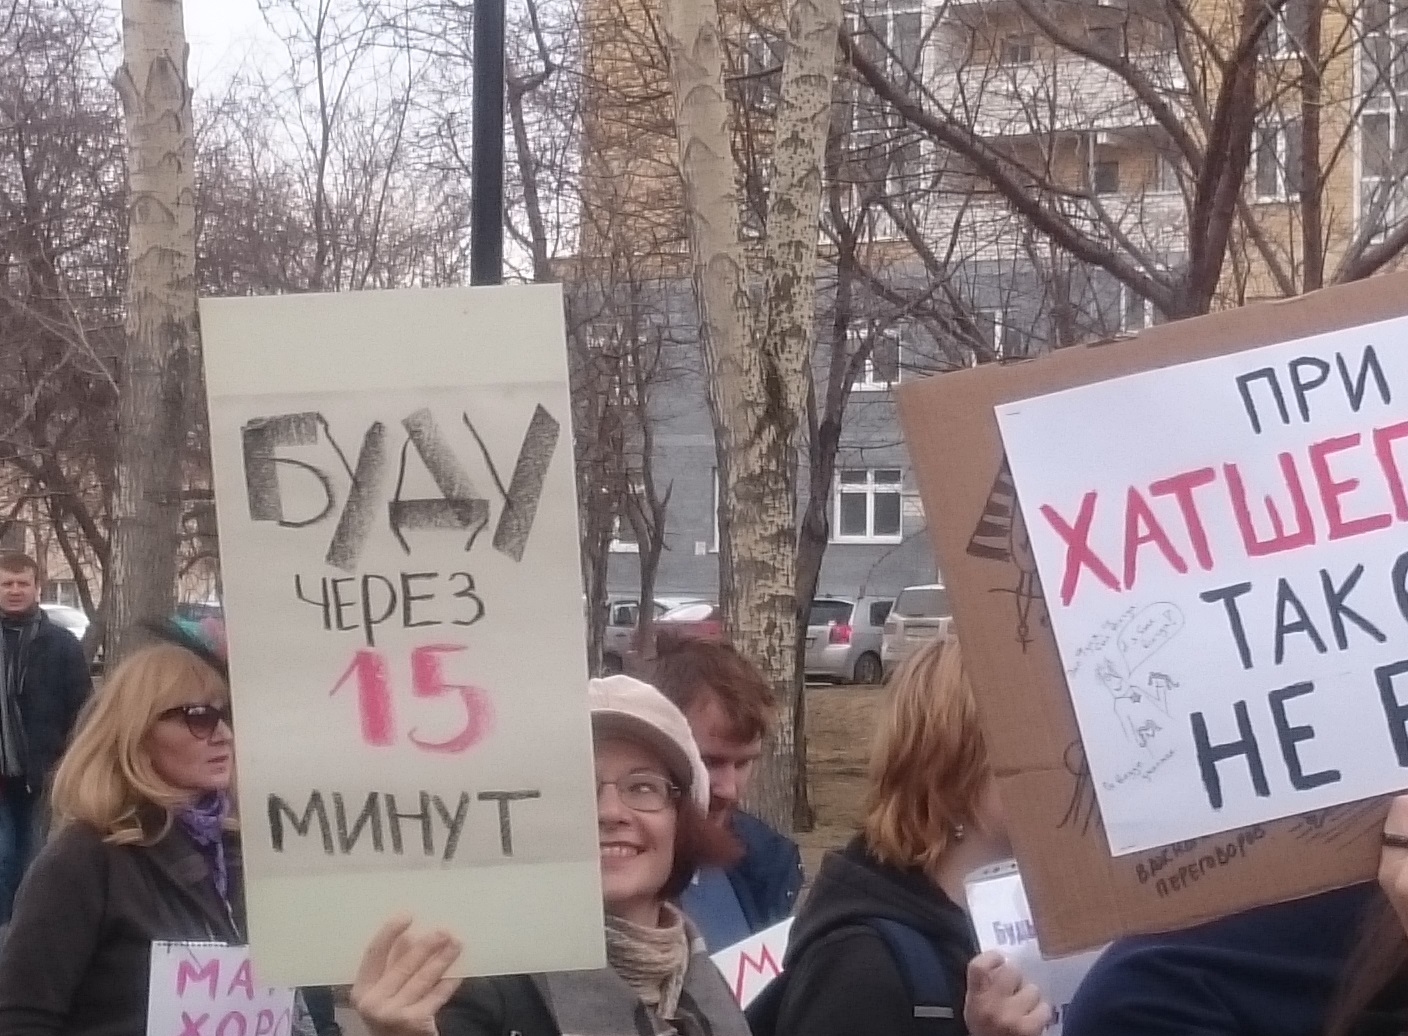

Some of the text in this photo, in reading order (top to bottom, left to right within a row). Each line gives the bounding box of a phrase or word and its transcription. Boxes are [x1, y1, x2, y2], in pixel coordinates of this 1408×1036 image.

[1235, 344, 1392, 435] ПРИ
[241, 403, 560, 571] БУДУ
[295, 571, 486, 646] ЧЕРЕЗ
[329, 643, 498, 755] 15
[1189, 681, 1342, 811] НЕ
[266, 788, 542, 863] МИНУТ
[175, 957, 256, 1001] МА
[734, 942, 782, 1006] М
